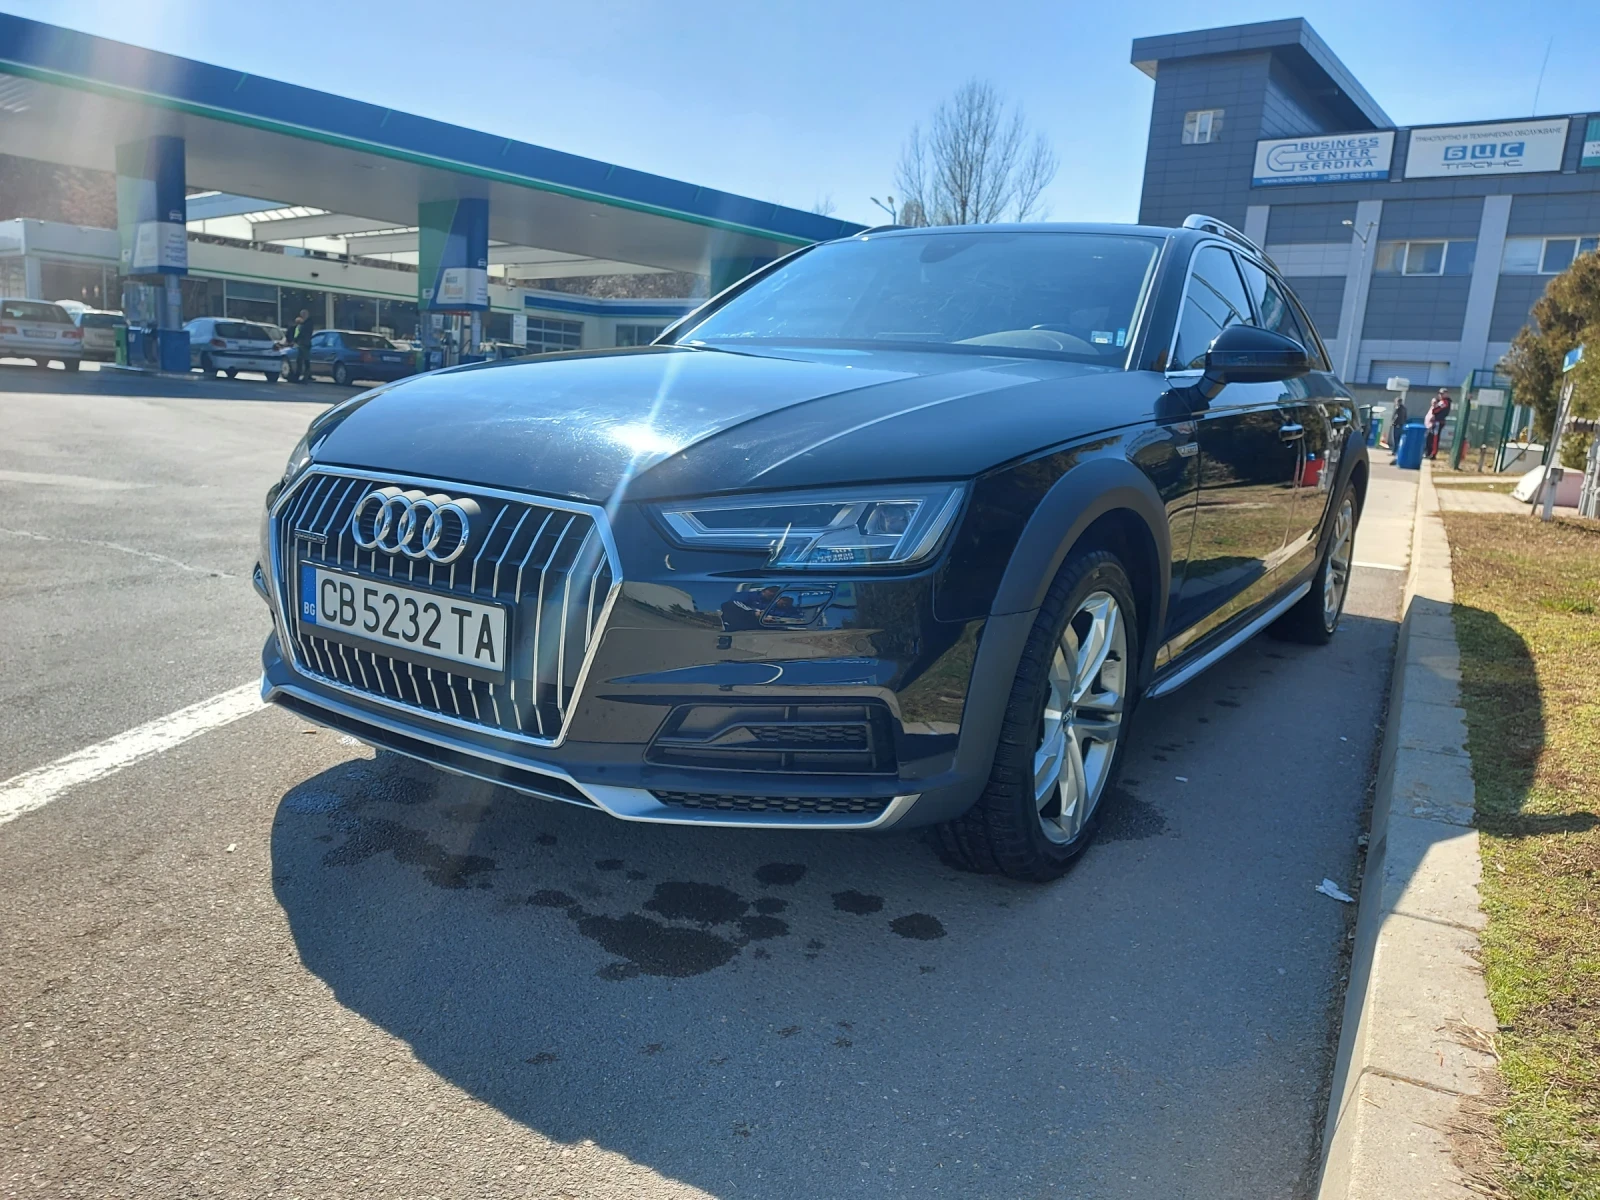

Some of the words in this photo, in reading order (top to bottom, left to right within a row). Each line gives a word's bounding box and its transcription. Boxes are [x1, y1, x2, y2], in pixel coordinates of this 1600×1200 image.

[1300, 137, 1379, 151] BUSINESS
[1306, 149, 1370, 161] CENTER
[1299, 159, 1374, 171] SERDIKA
[303, 601, 316, 616] BG
